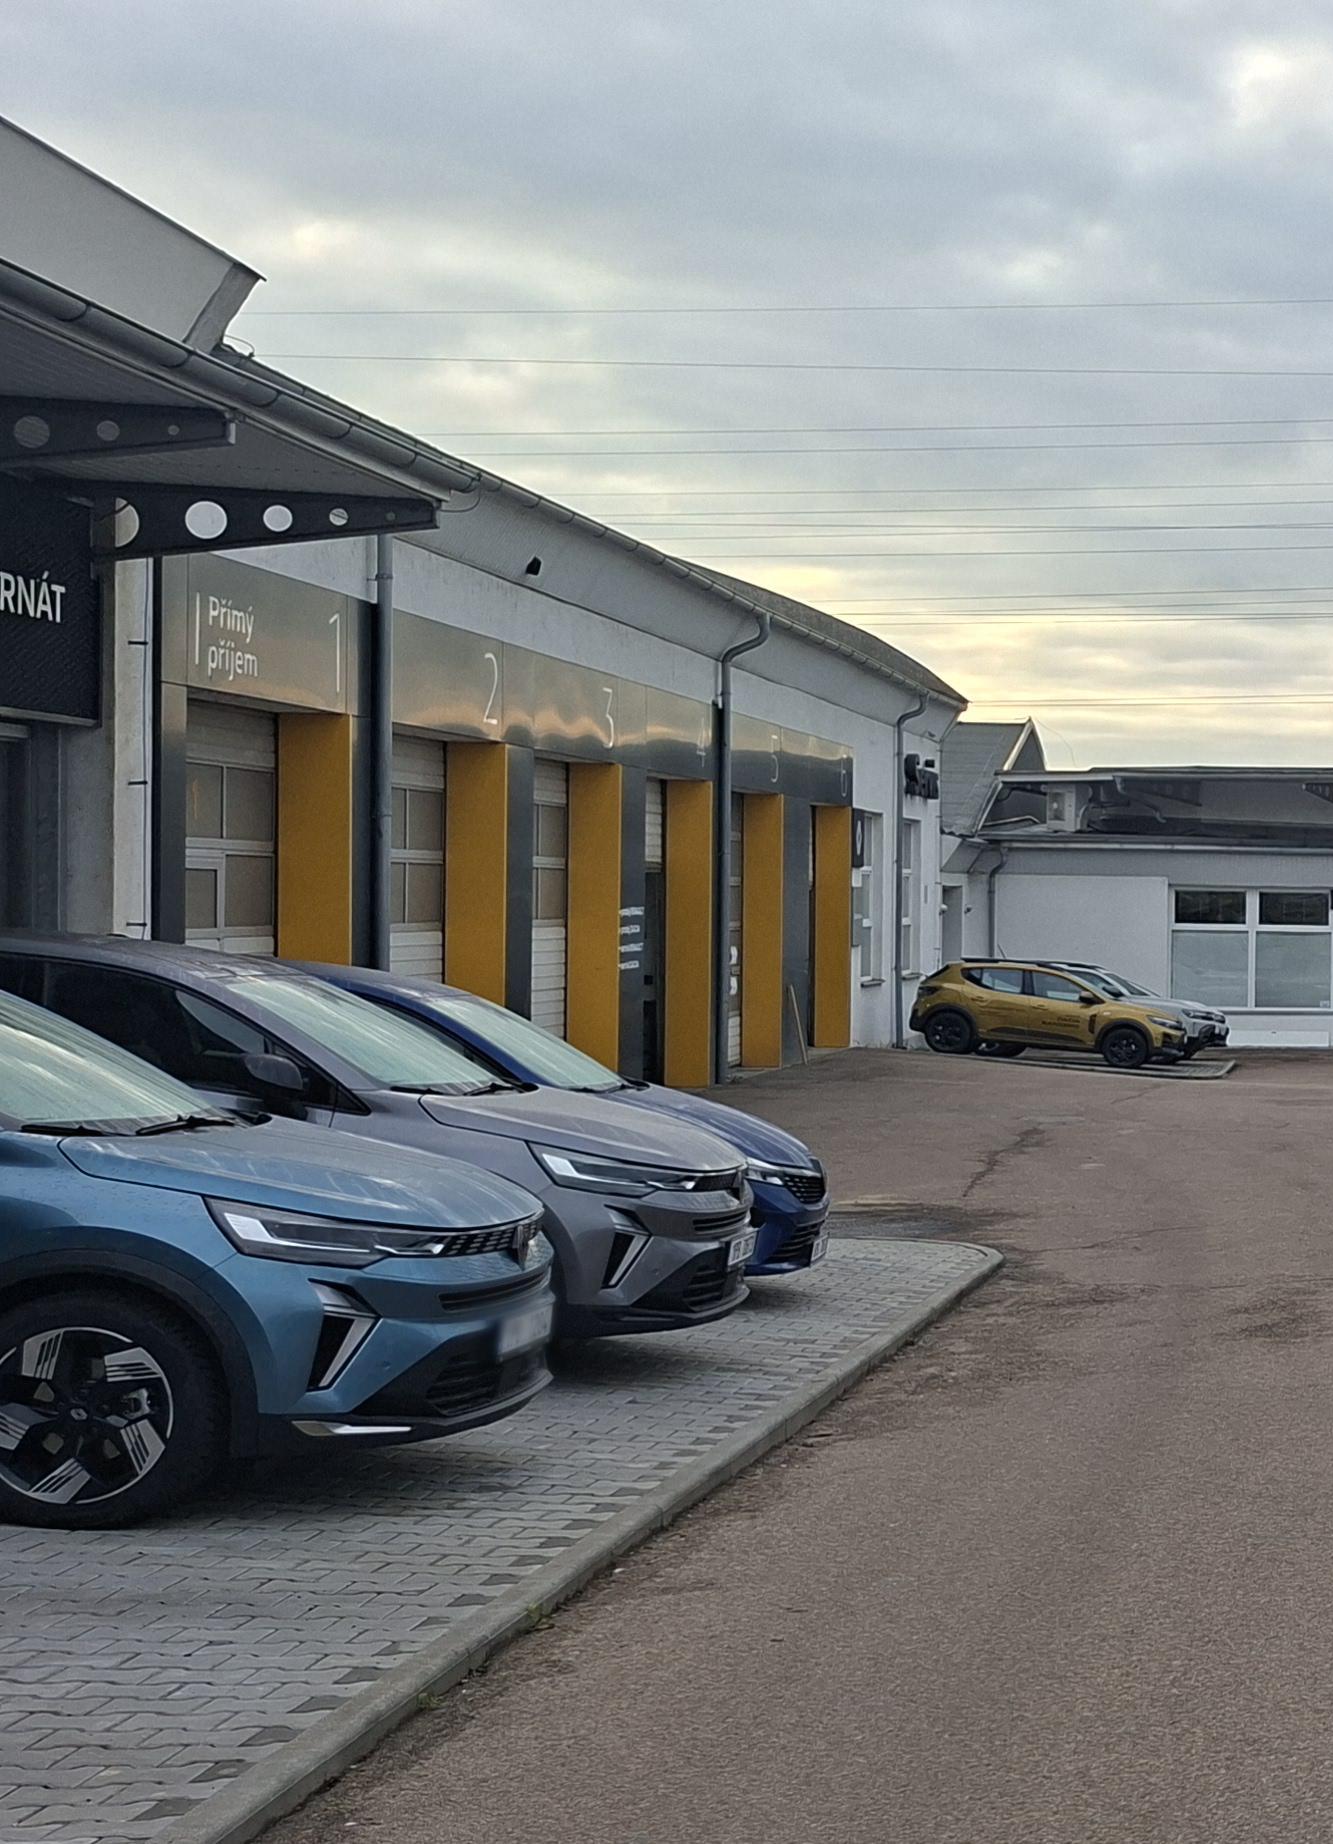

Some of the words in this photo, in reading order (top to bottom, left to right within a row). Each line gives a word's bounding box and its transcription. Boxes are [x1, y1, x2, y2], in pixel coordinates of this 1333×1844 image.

[0, 571, 66, 623] RNÁT
[208, 595, 255, 642] Přímý
[207, 639, 258, 680] příjem
[328, 613, 341, 693] 1
[483, 652, 499, 725] 2
[602, 687, 615, 749] 3
